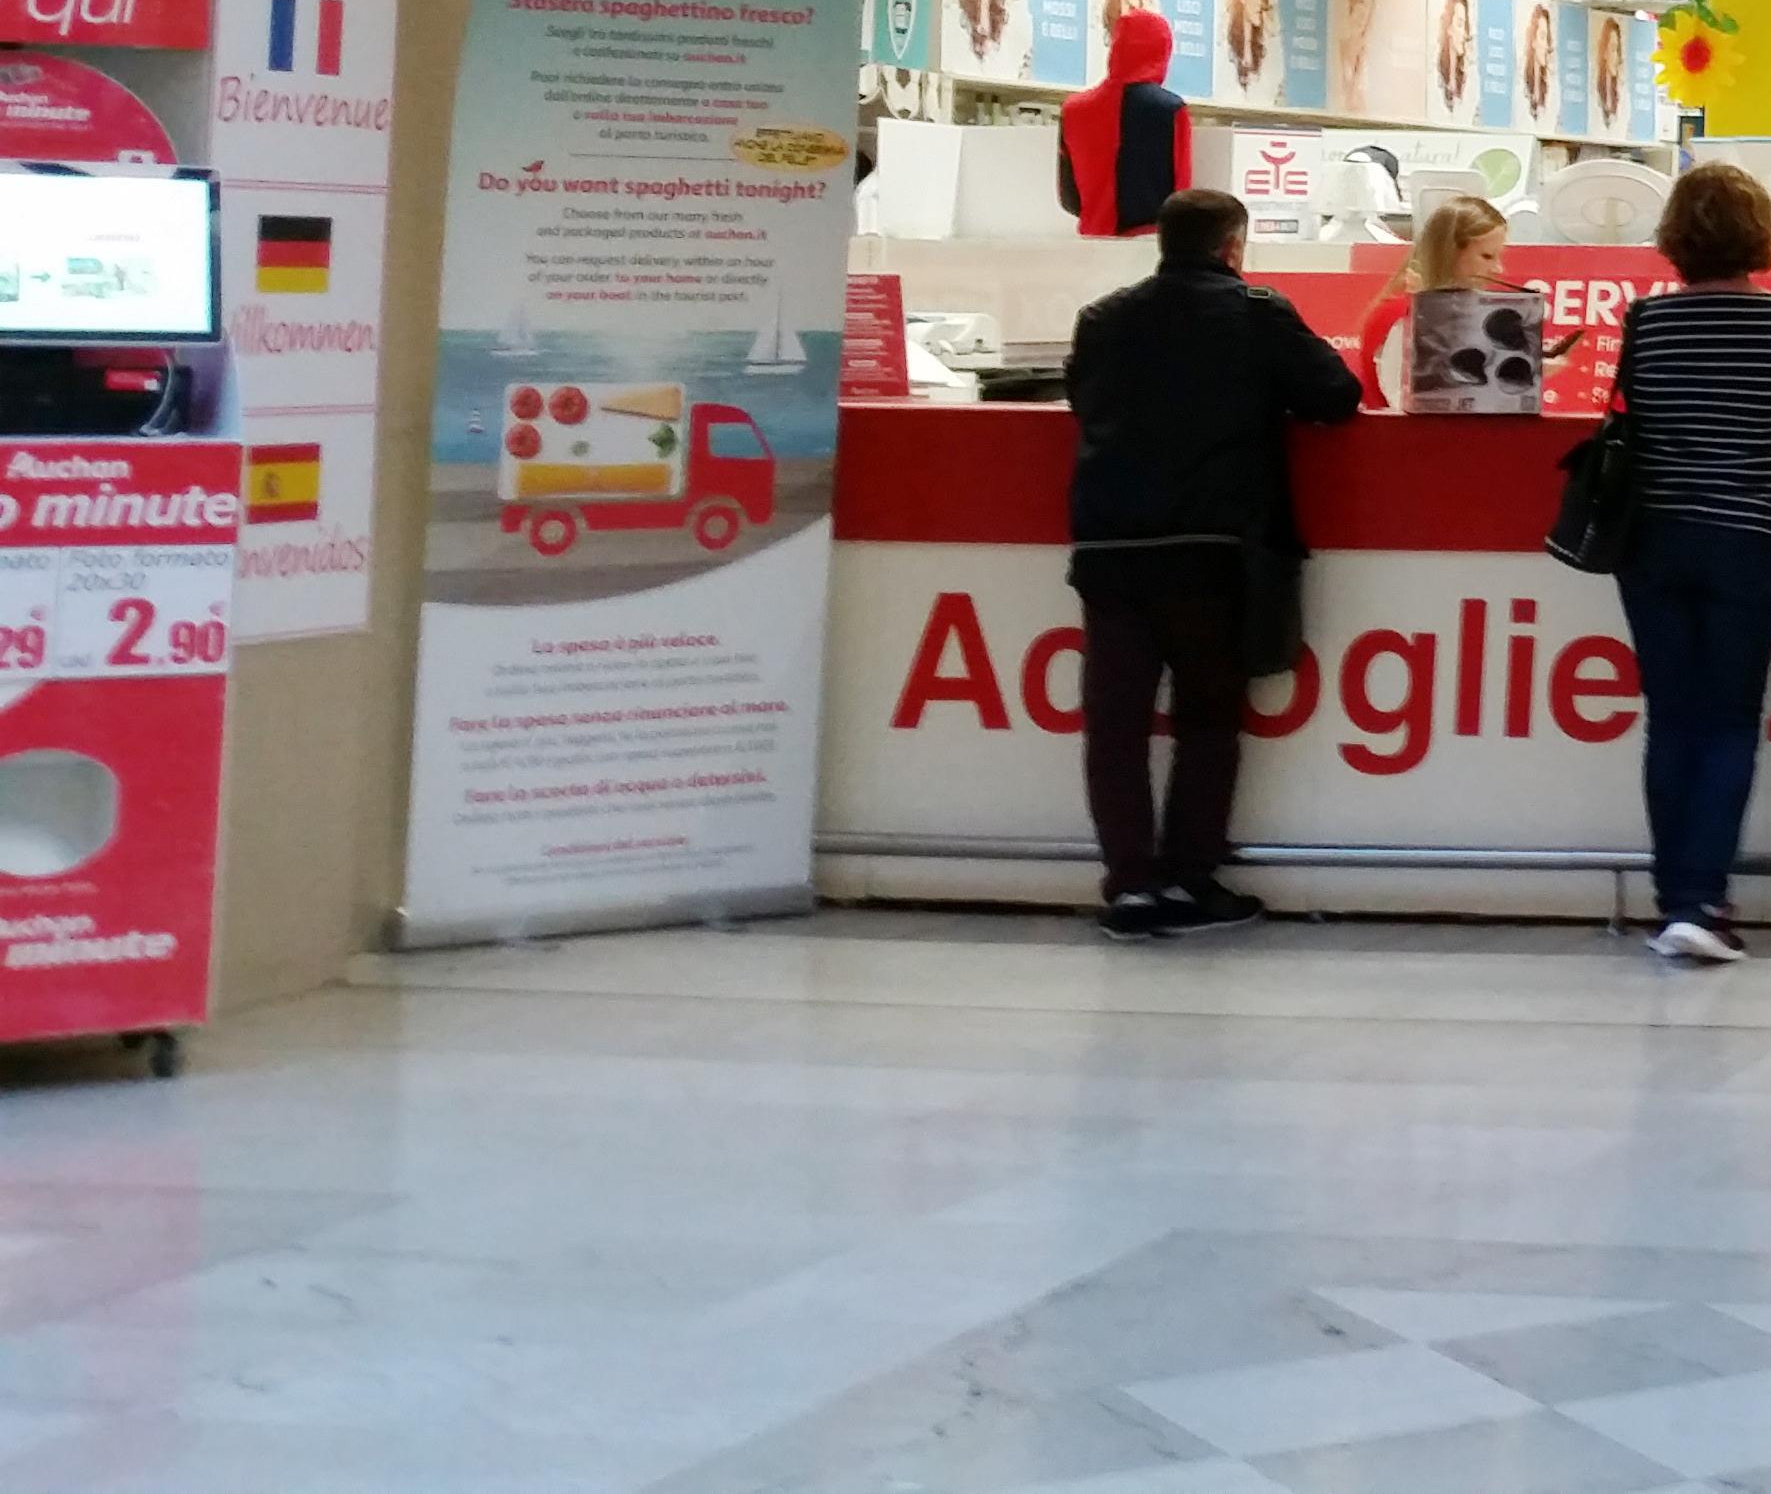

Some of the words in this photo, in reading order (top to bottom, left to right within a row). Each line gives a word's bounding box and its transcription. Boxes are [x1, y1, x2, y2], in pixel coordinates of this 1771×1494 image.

[740, 6, 816, 26] fresco?
[218, 73, 391, 131] Bienvenue
[478, 171, 509, 191] Do
[517, 174, 558, 196] you
[563, 178, 619, 195] want
[624, 177, 729, 200] spaghetti
[736, 180, 826, 203] tonight?
[6, 451, 132, 480] Auchan
[32, 483, 238, 528] minute
